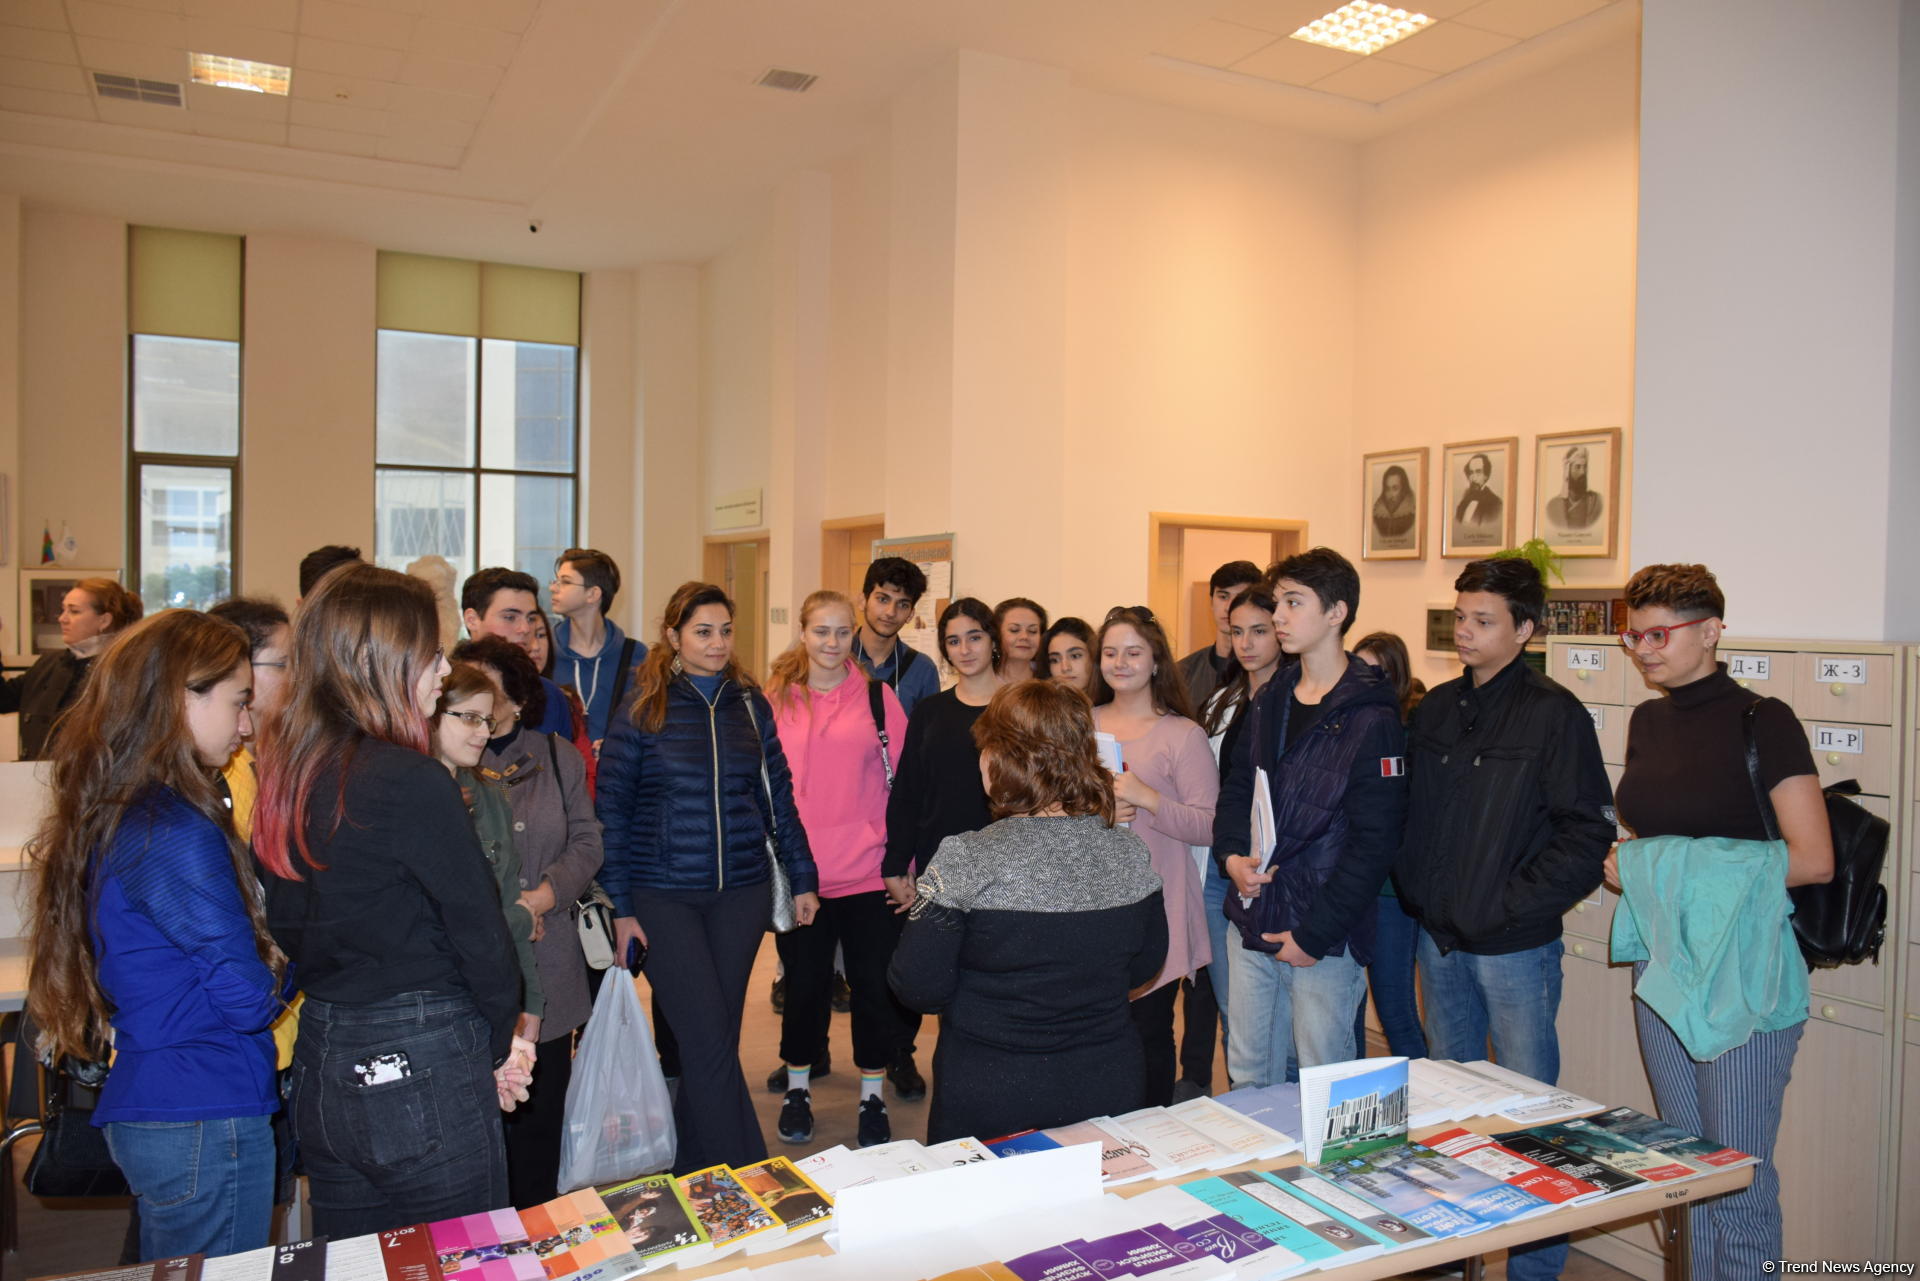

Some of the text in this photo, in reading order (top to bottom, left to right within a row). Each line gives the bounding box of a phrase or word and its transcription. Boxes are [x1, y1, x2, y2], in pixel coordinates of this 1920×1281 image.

[1571, 653, 1580, 664] А
[1591, 654, 1599, 665] Б
[1732, 660, 1744, 674] Д
[1757, 661, 1766, 674] Е
[1823, 664, 1839, 677] Ж
[1851, 664, 1860, 678] З
[1820, 732, 1832, 745] П
[1847, 734, 1857, 747] Р
[647, 1179, 669, 1188] 10
[384, 1227, 416, 1238] 2019
[280, 1241, 313, 1252] 2018
[388, 1237, 401, 1247] 7
[1127, 1243, 1162, 1256] ХИМИИ
[280, 1253, 294, 1264] 8
[1133, 1253, 1176, 1268] ЖУРНАЛ
[1044, 1260, 1079, 1275] ХИМИИ
